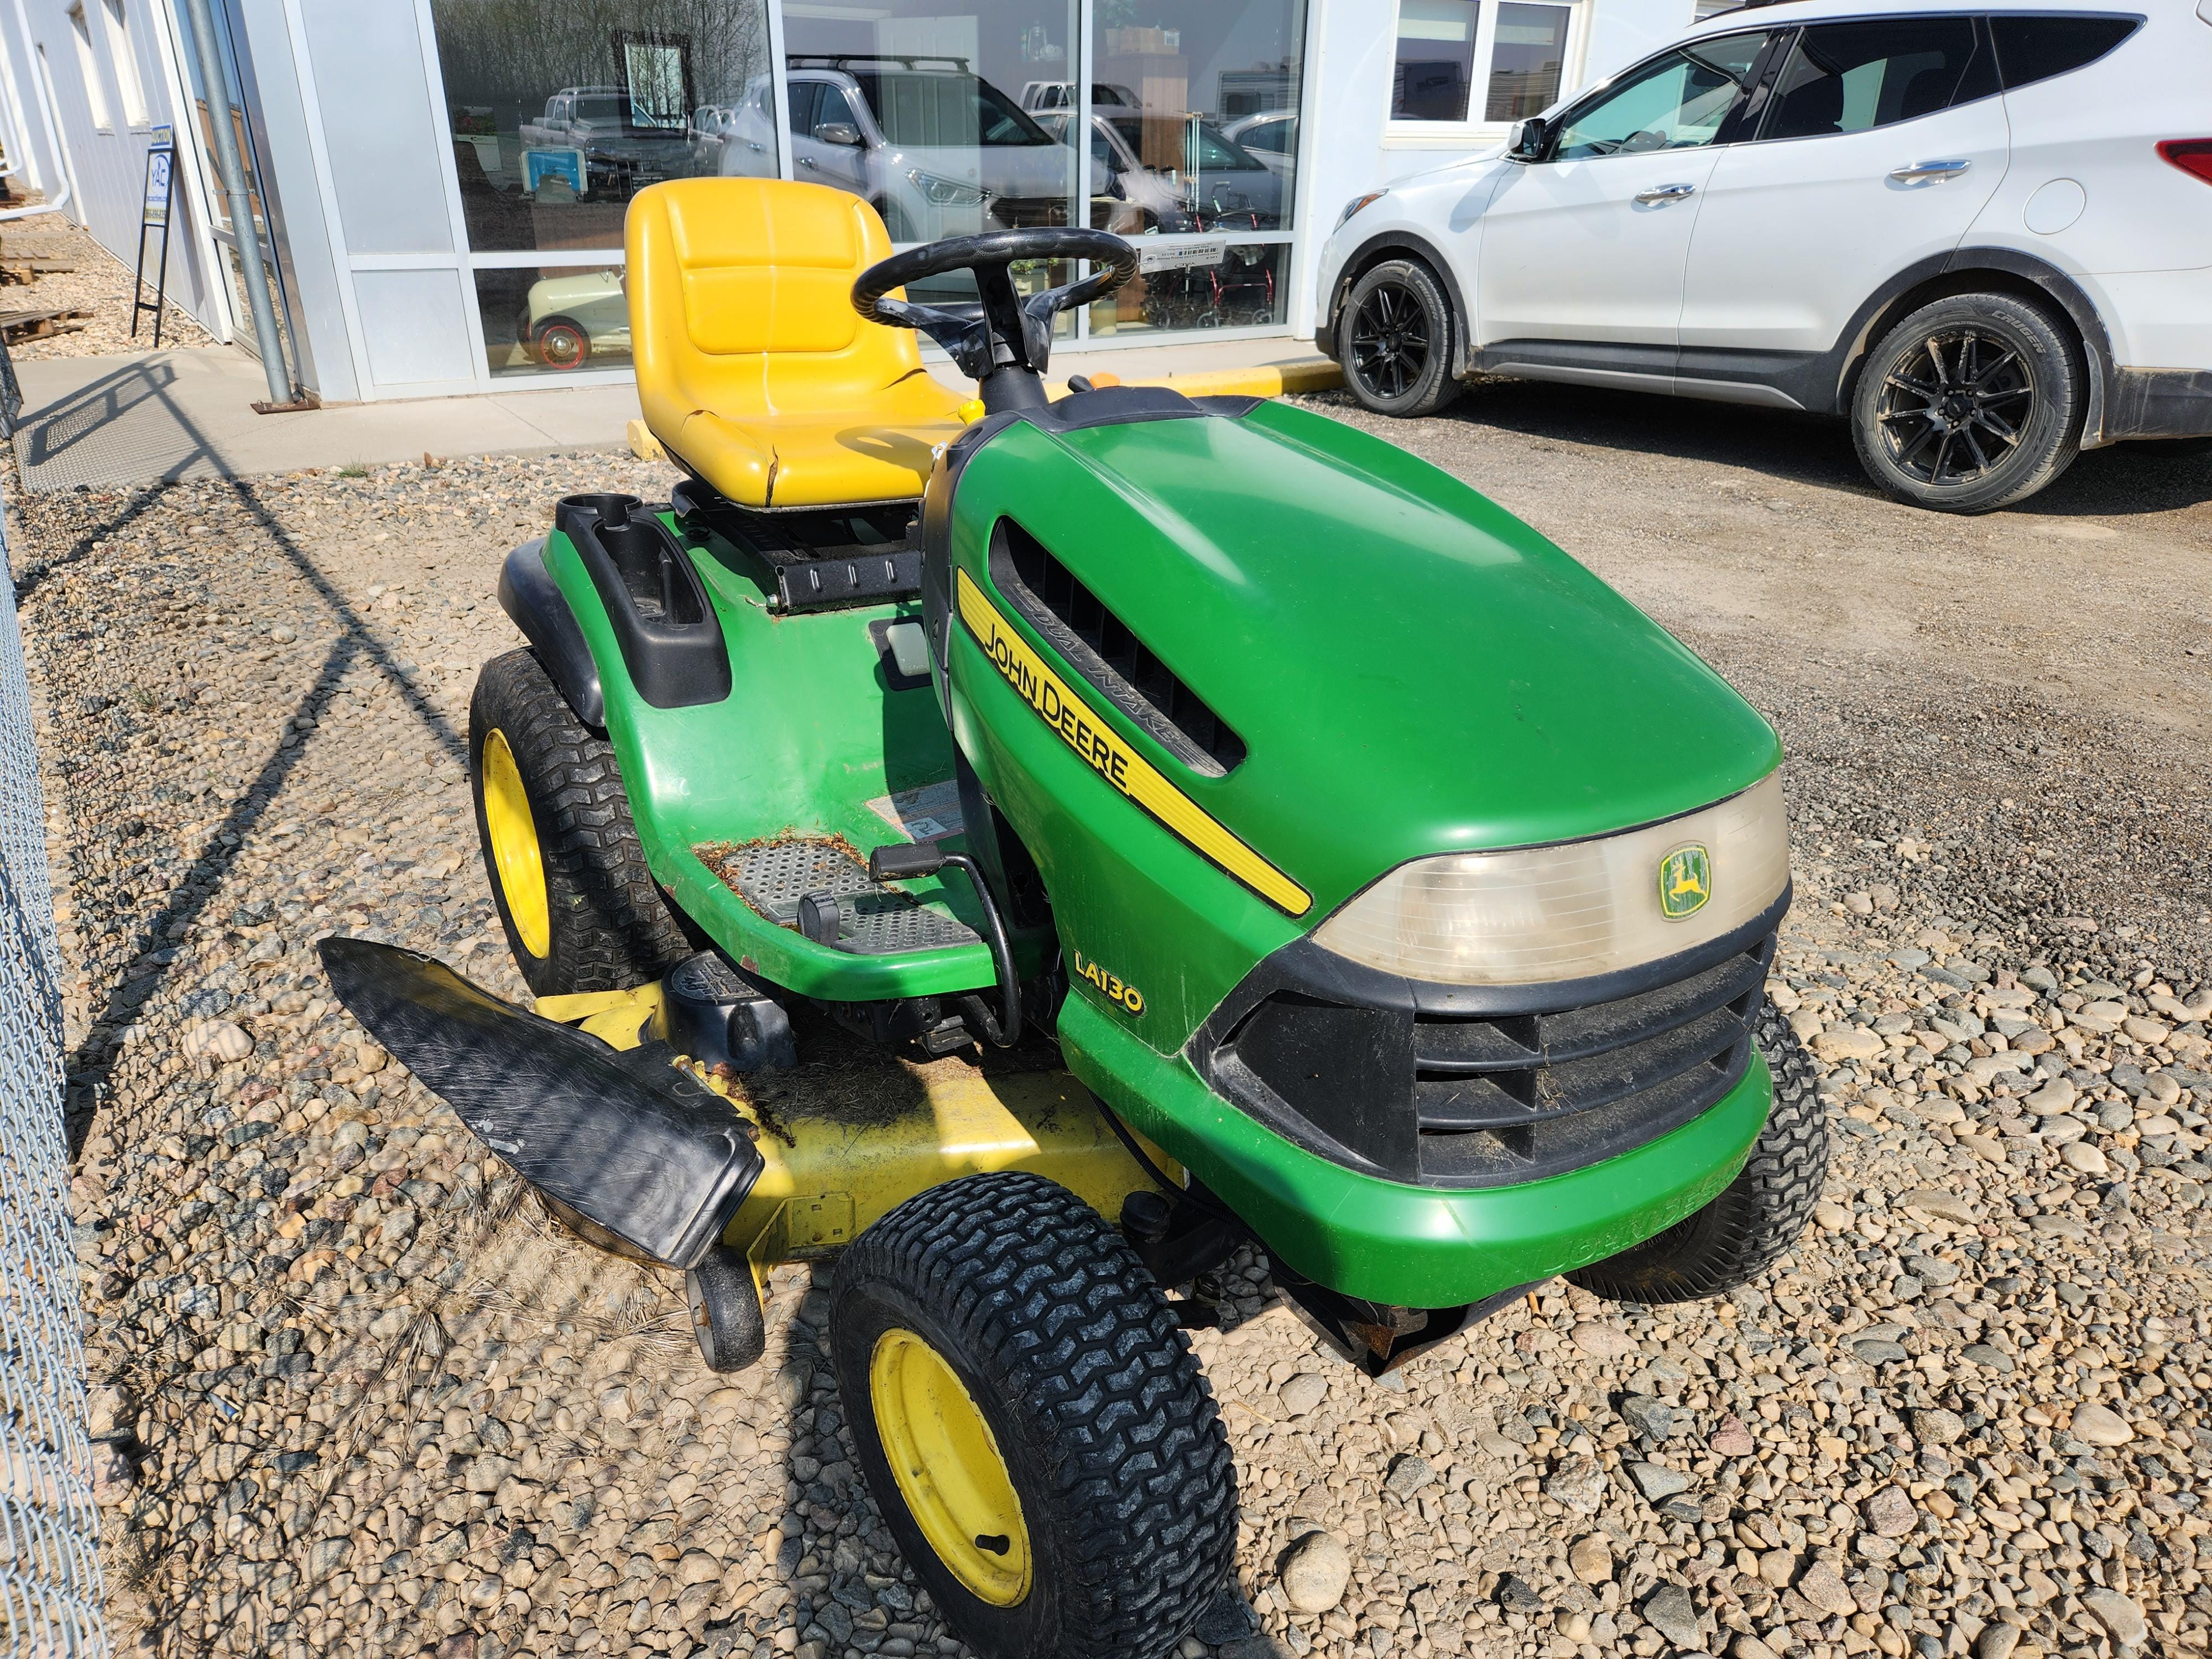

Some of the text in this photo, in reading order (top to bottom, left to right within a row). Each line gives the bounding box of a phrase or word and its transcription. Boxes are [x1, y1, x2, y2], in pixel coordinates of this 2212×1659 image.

[151, 168, 165, 187] YAC
[985, 623, 1129, 789] JOHN DEERE
[1031, 612, 1181, 743] DUAL INTAKE
[704, 960, 754, 995] EDGE
[1074, 951, 1144, 1013] LA130
